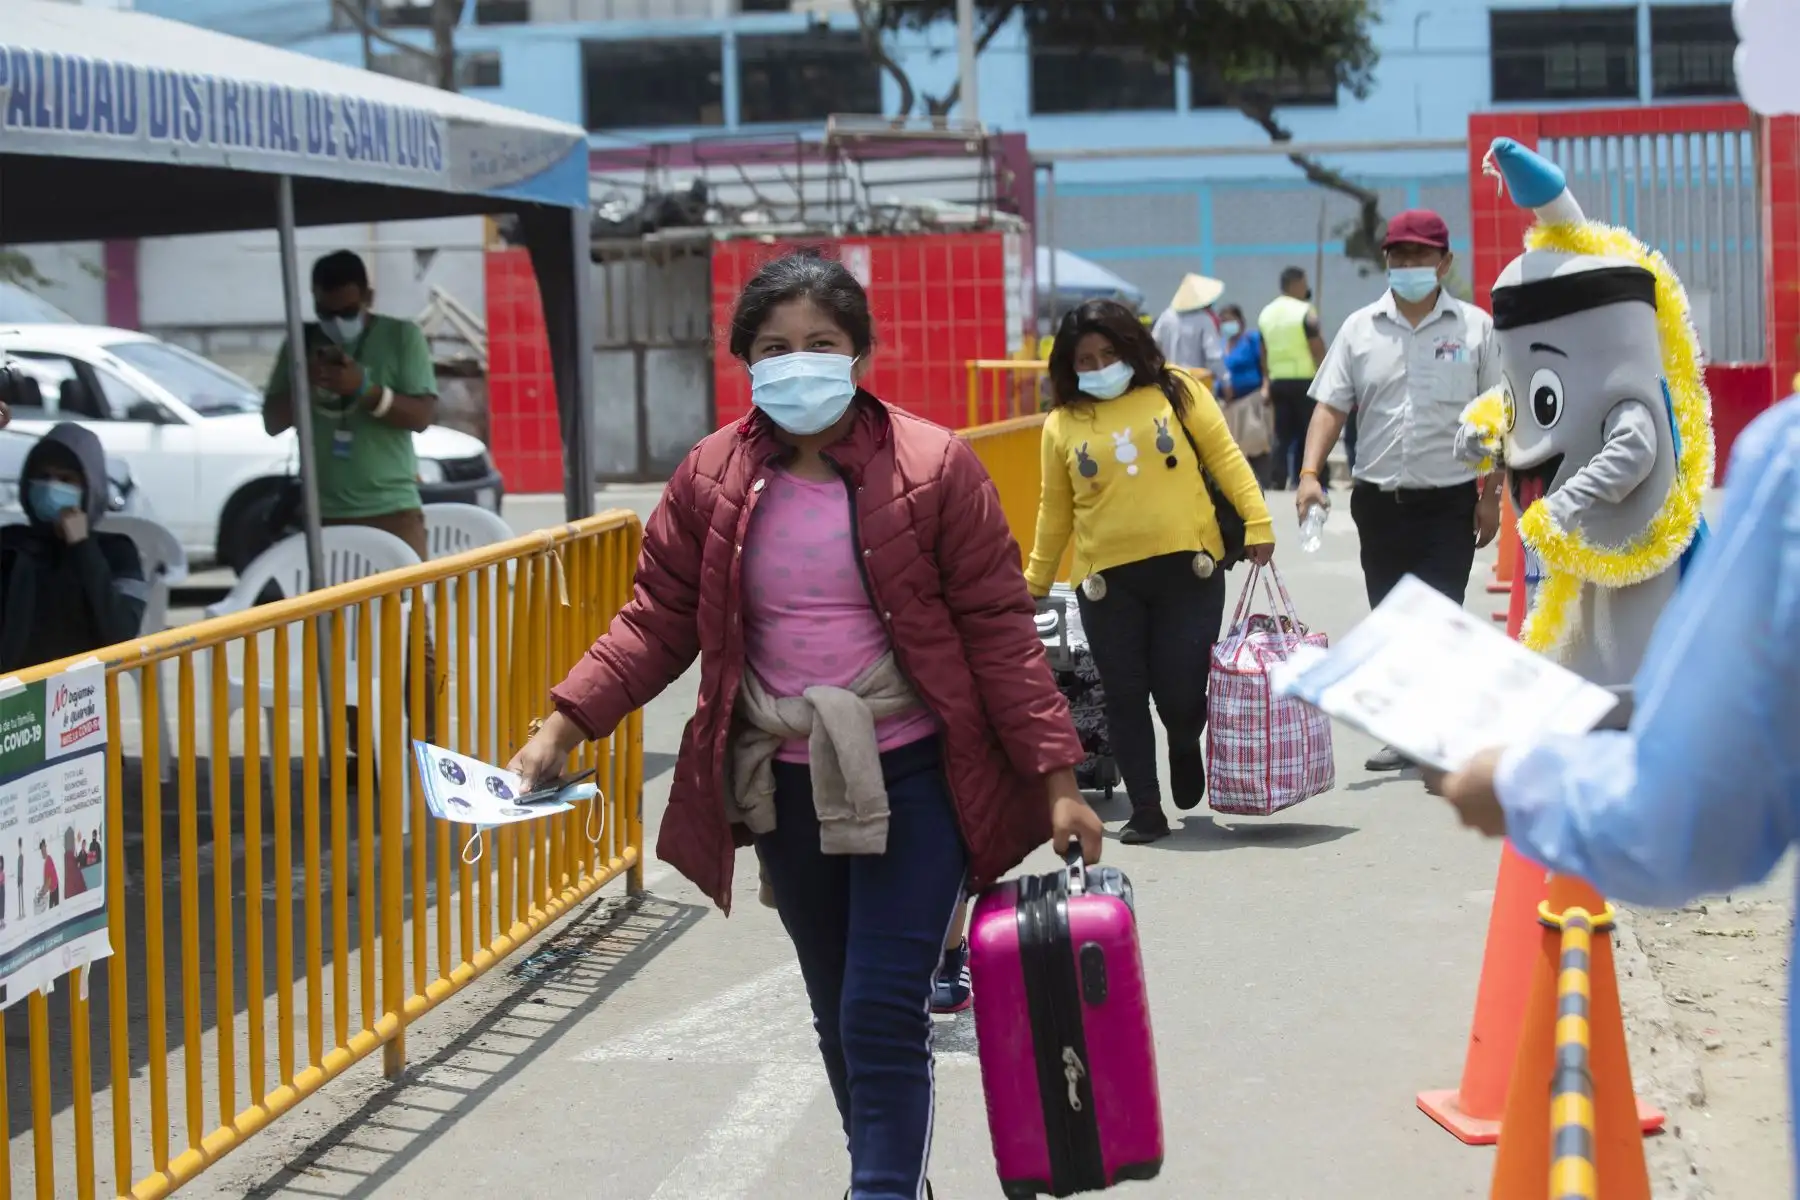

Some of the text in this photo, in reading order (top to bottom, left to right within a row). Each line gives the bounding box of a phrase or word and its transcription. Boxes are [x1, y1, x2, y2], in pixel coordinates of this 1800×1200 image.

[147, 67, 298, 153] DISTRITAL
[305, 90, 338, 156] DE
[340, 93, 390, 164] SAN
[393, 105, 443, 172] LUIS
[4, 723, 42, 753] COVID-19
